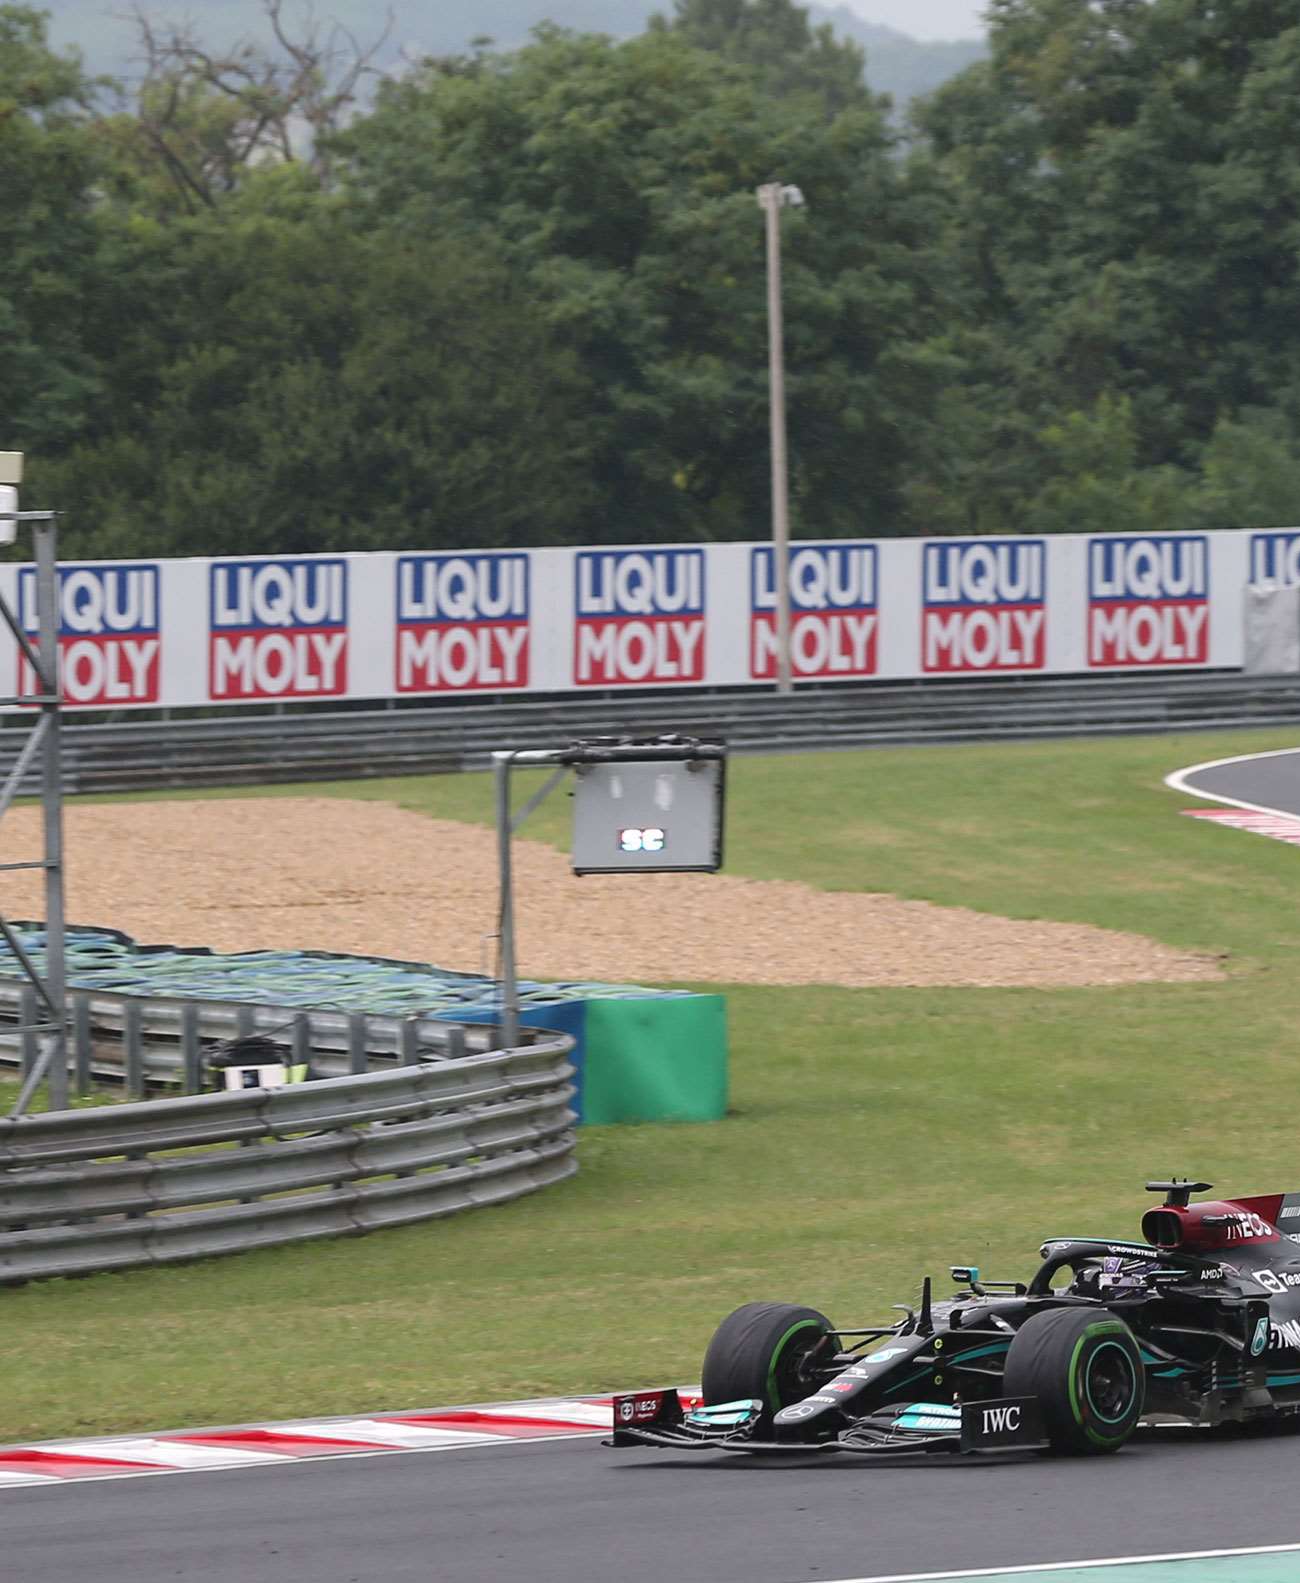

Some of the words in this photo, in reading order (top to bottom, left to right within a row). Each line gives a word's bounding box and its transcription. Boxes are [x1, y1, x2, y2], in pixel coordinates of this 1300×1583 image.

[214, 562, 344, 629] LIQUI
[401, 554, 525, 620] LIQUI
[580, 550, 701, 614] LIQUI
[755, 549, 873, 608] LQUI
[926, 542, 1041, 602] LIQUI
[1093, 537, 1205, 598] LIQUI
[23, 570, 155, 633] LQUI
[1093, 601, 1208, 664] MOLY
[212, 631, 347, 698] MOLY
[401, 625, 529, 688] MOLY
[579, 617, 703, 681] MOLY
[926, 607, 1044, 670] MOLY
[621, 828, 664, 851] SC
[1111, 1246, 1158, 1258] CROWDSTRIKE
[635, 1400, 656, 1412] INEOS
[982, 1406, 1021, 1434] IWC
